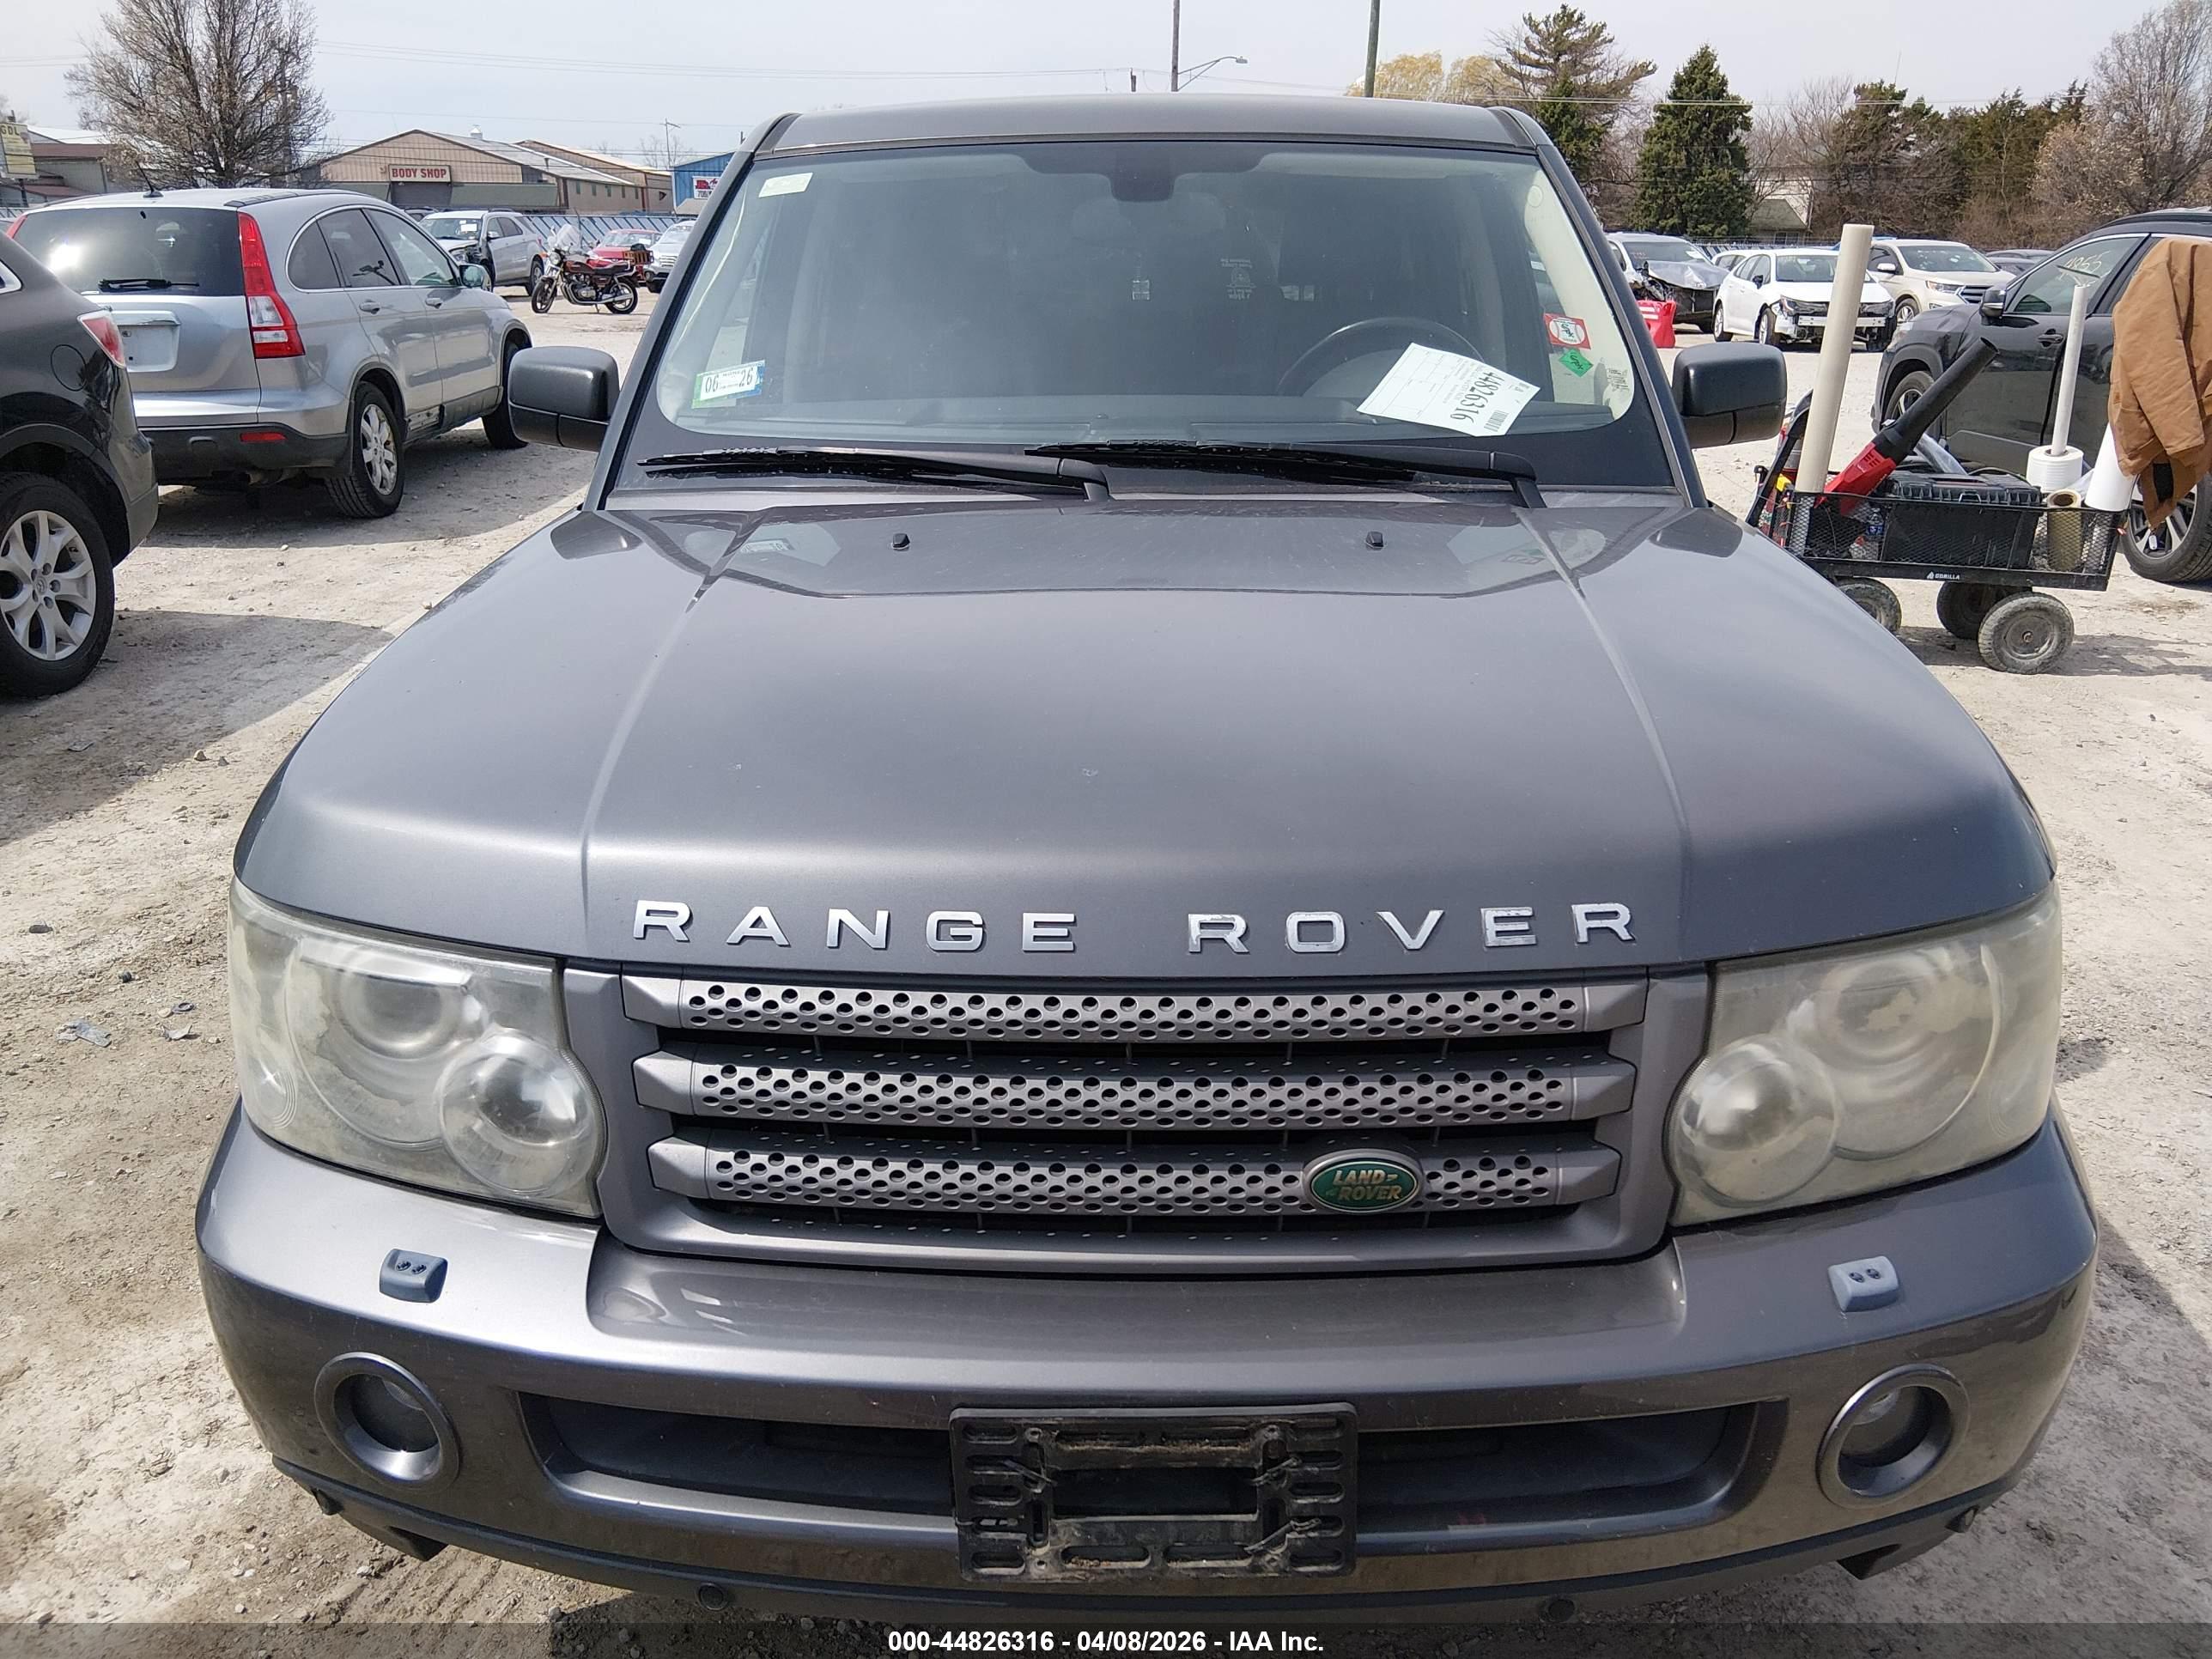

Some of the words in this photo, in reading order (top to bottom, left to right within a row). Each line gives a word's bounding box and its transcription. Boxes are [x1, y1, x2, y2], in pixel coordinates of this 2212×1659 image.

[392, 168, 417, 178] BODY
[420, 168, 447, 179] SHOP
[705, 374, 720, 393] 06
[738, 367, 754, 388] 26
[1449, 371, 1505, 424] 44826316
[633, 899, 1078, 953] RANGE
[1188, 902, 1637, 955] ROVER
[1338, 1185, 1402, 1200] ROVER
